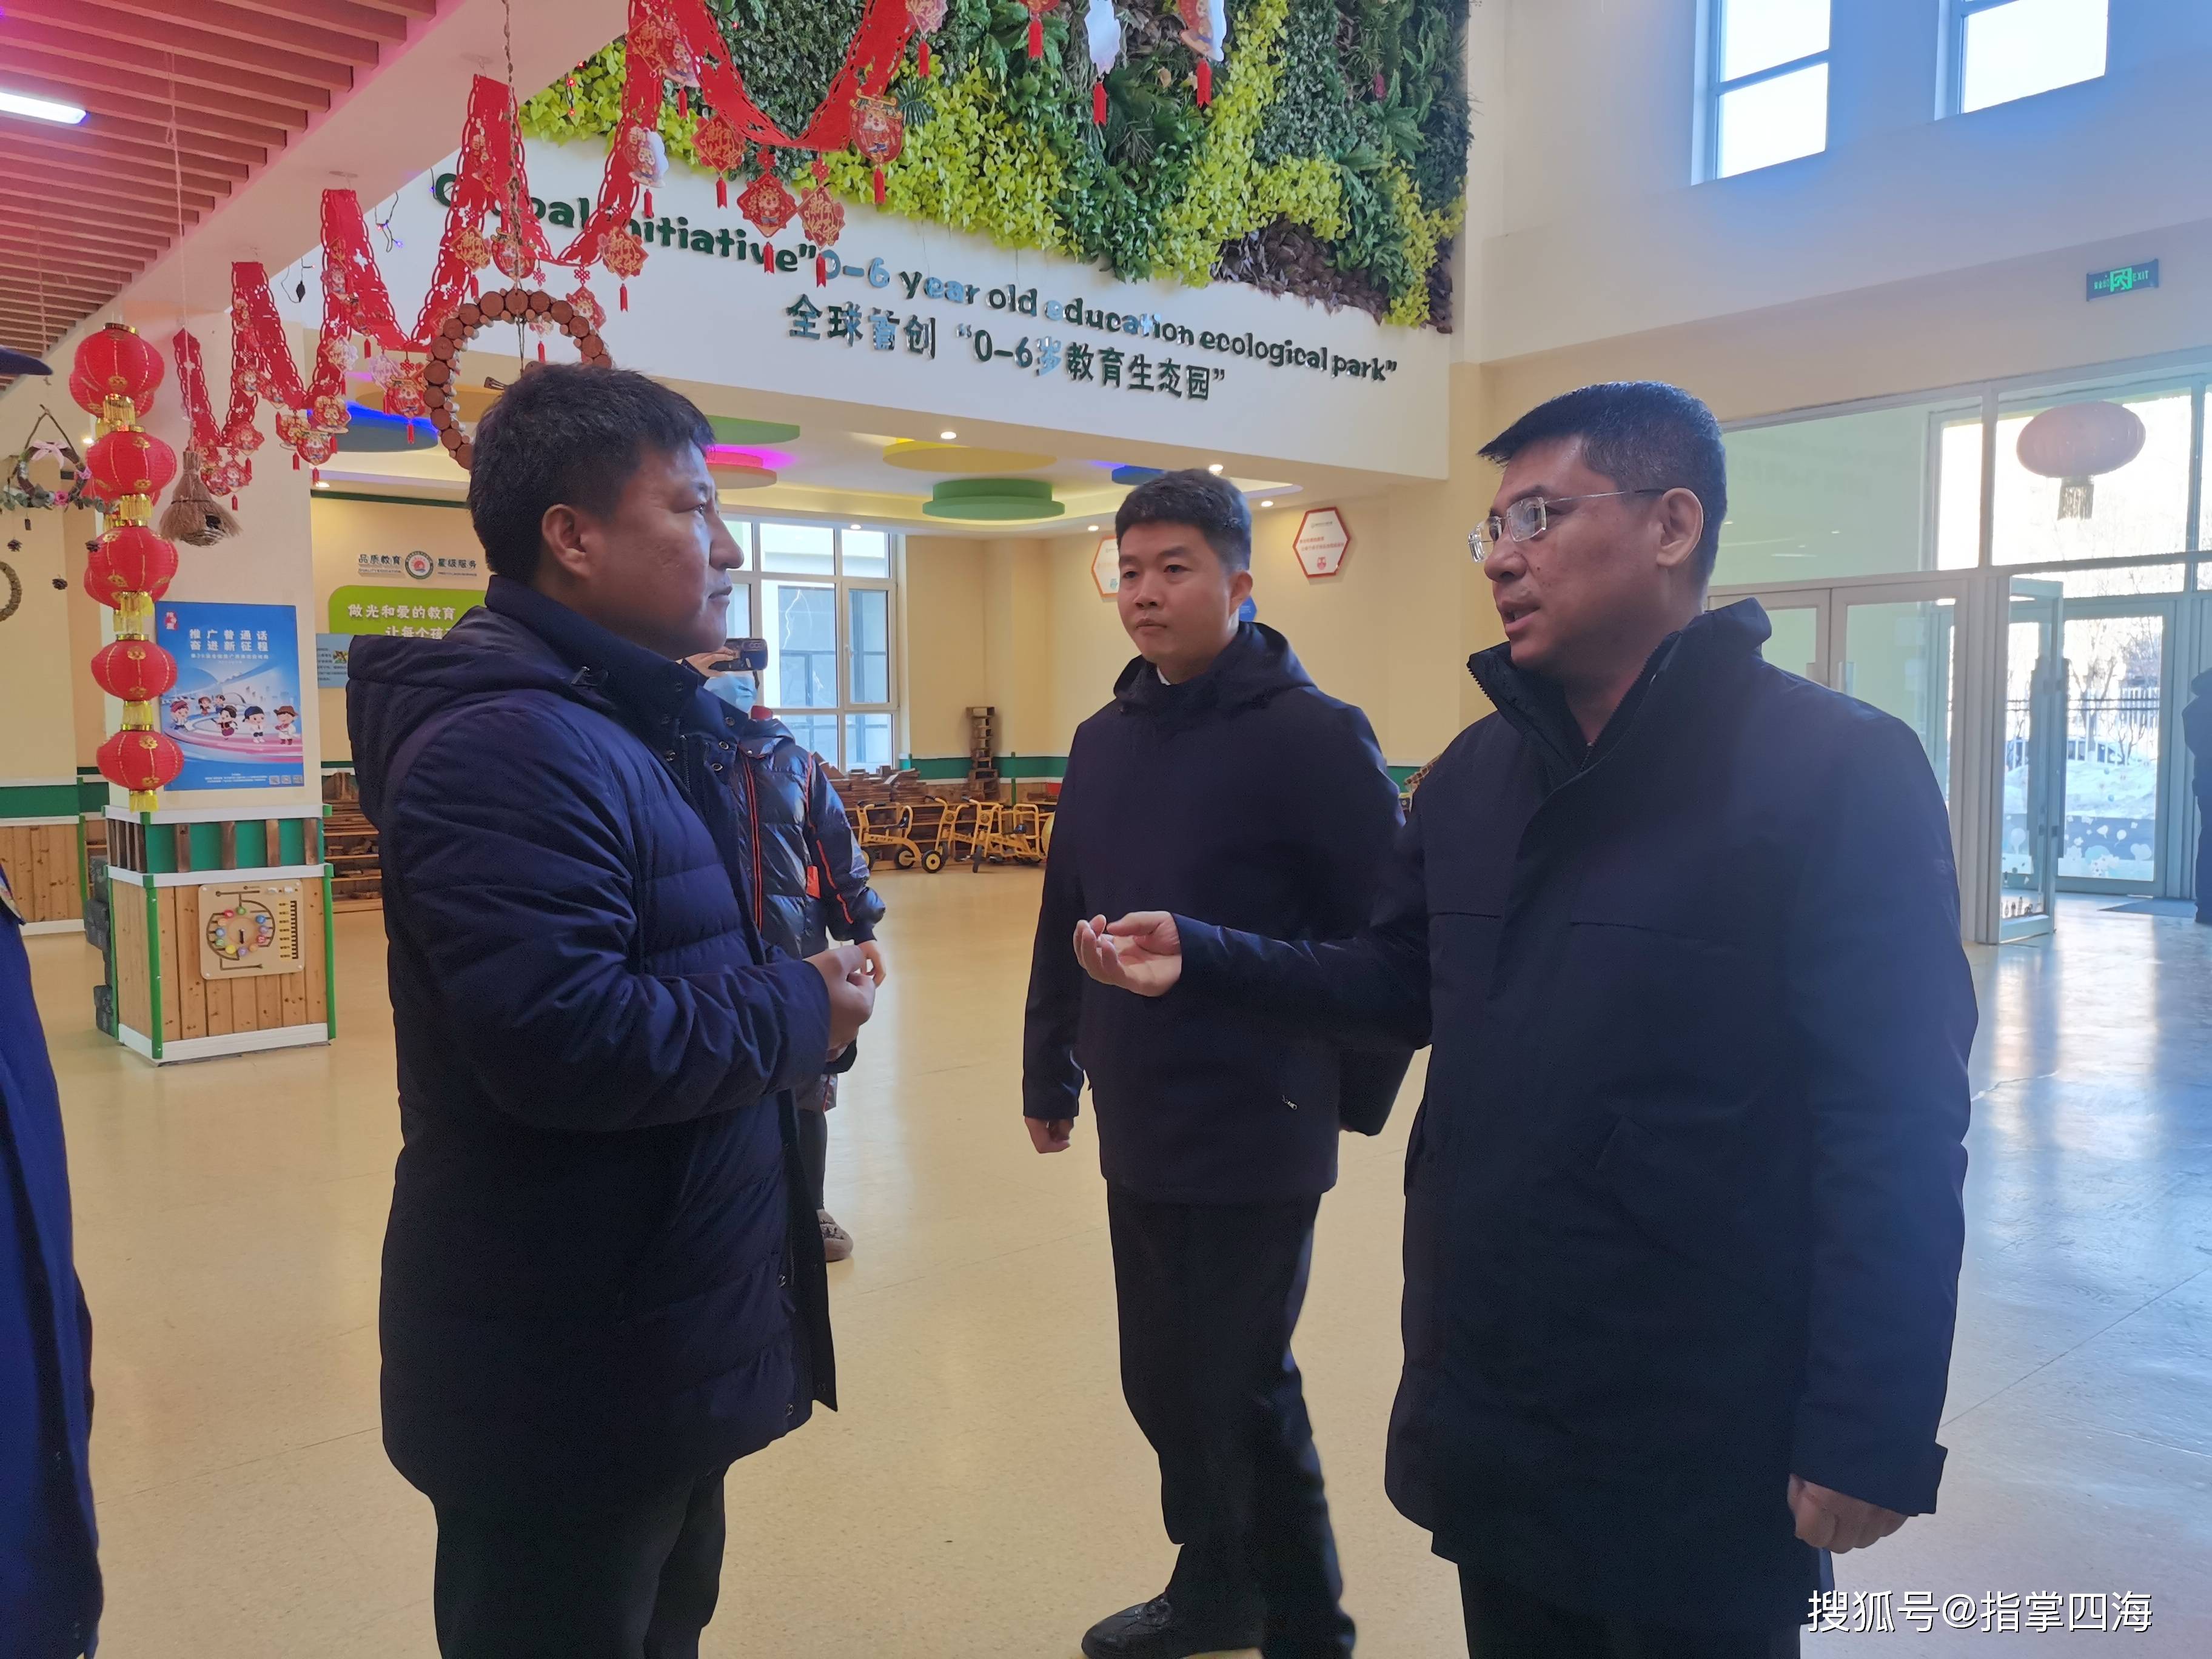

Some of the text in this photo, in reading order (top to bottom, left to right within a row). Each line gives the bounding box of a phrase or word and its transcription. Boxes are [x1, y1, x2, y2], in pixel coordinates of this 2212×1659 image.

[2133, 270, 2149, 281] EXIT
[786, 293, 936, 359] 全球首创
[899, 271, 980, 304] year
[987, 284, 1037, 317] old
[1045, 298, 1194, 346] education
[1199, 330, 1327, 371] ecological
[358, 554, 401, 565] 品质教育
[438, 558, 477, 569] 星级服务
[347, 604, 455, 621] 做光和爱的教育
[189, 628, 268, 641] 推广普通话
[385, 626, 451, 640] 让每个孩
[190, 640, 269, 652] 奋进新征程
